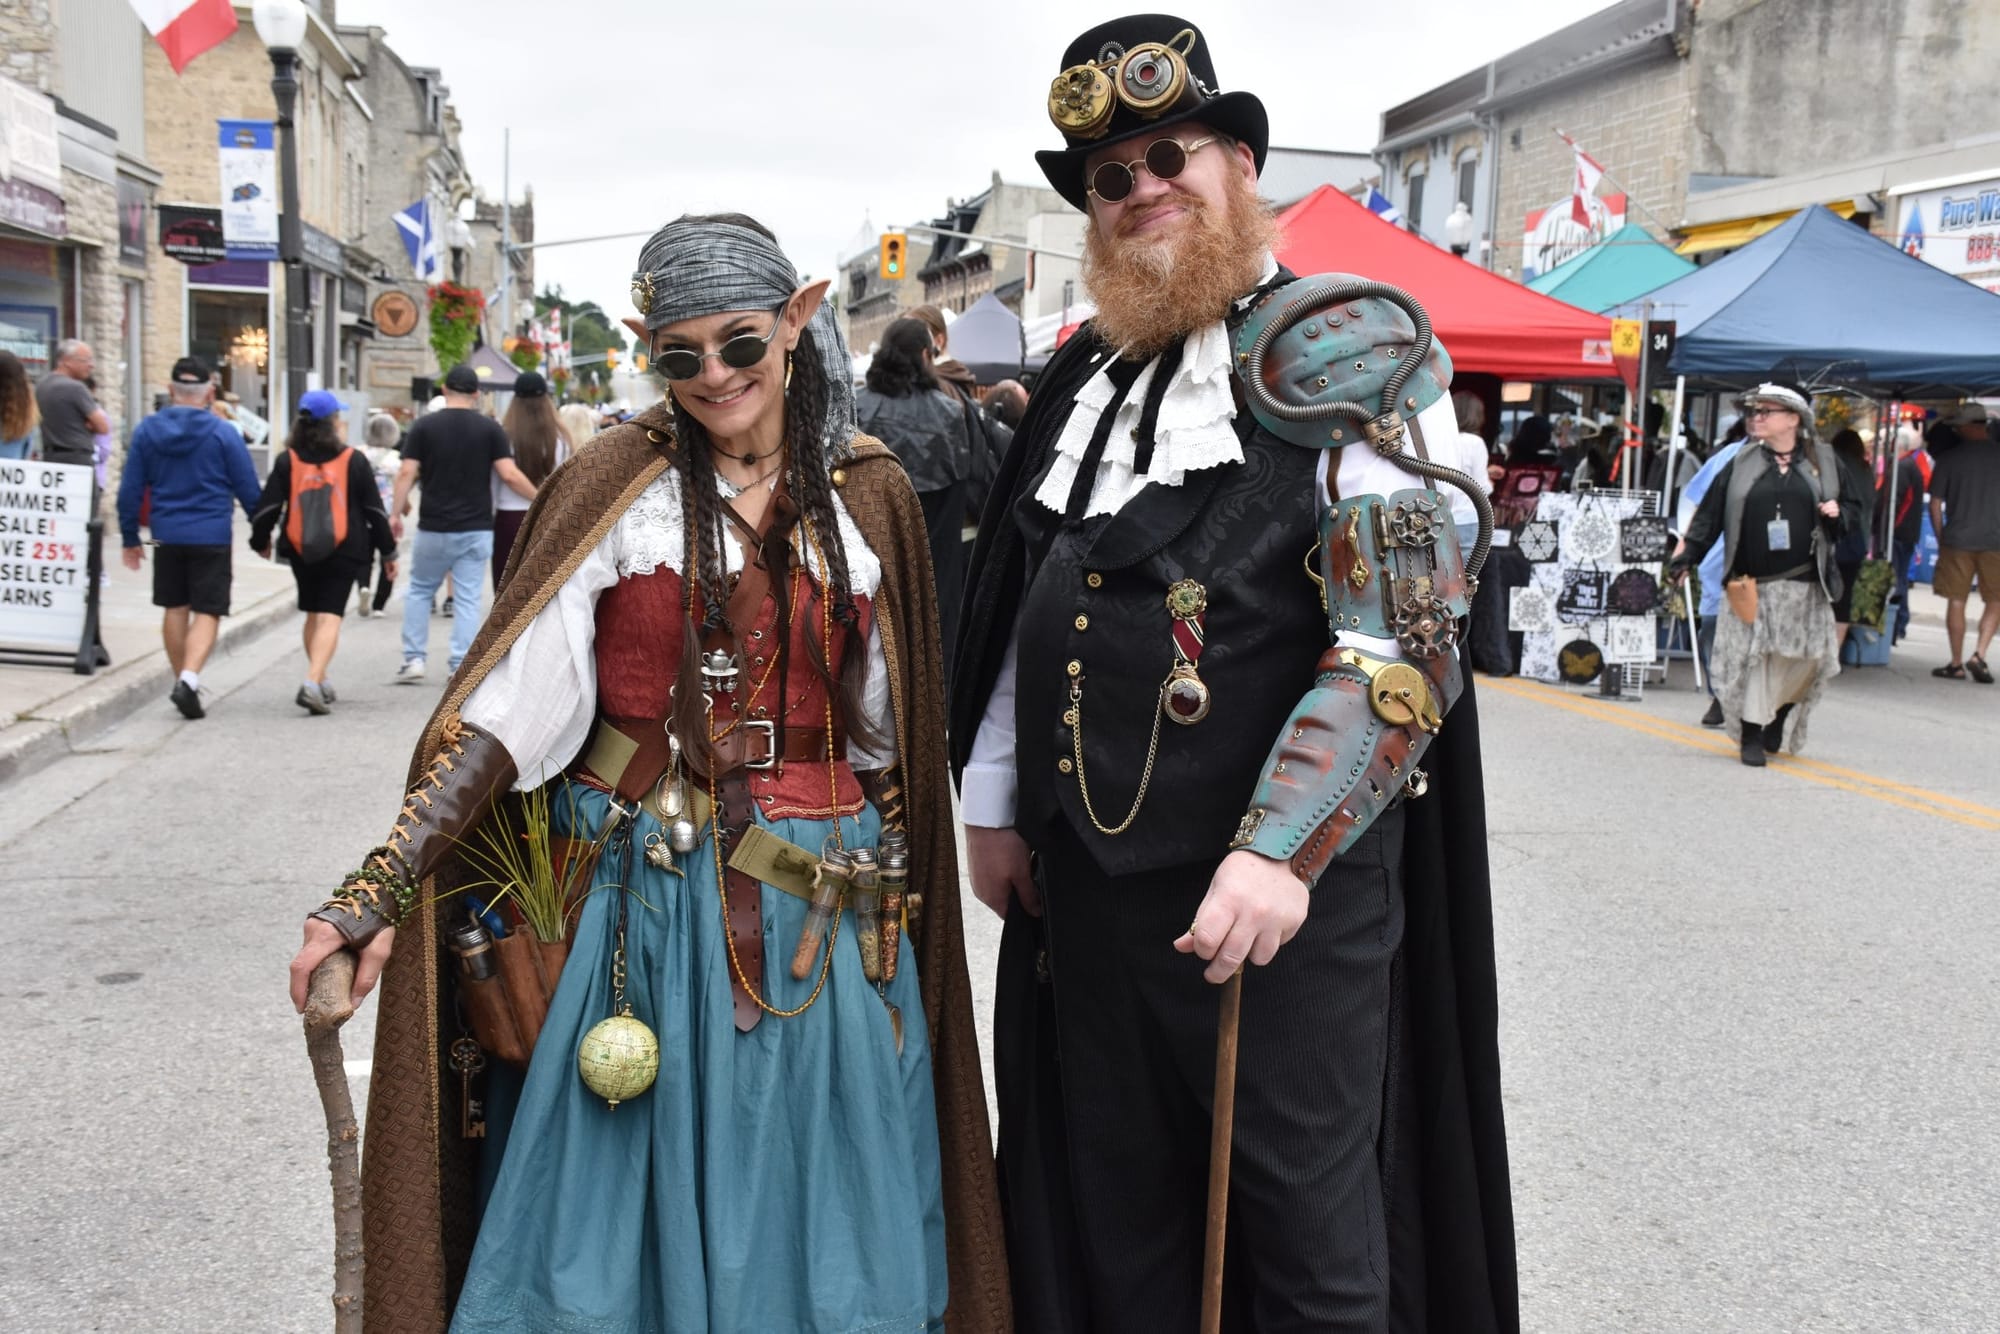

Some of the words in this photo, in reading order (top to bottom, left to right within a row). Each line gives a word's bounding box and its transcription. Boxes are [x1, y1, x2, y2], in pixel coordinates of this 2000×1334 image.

[1940, 199, 1976, 229] Pure
[1654, 333, 1668, 351] 34
[0, 468, 25, 485] ND
[41, 471, 65, 488] OF
[0, 491, 67, 513] MMER
[0, 515, 56, 537] SALE!
[2, 540, 25, 558] VE
[32, 542, 75, 562] 25%
[0, 564, 77, 586] SELECT
[0, 587, 53, 609] ARNS
